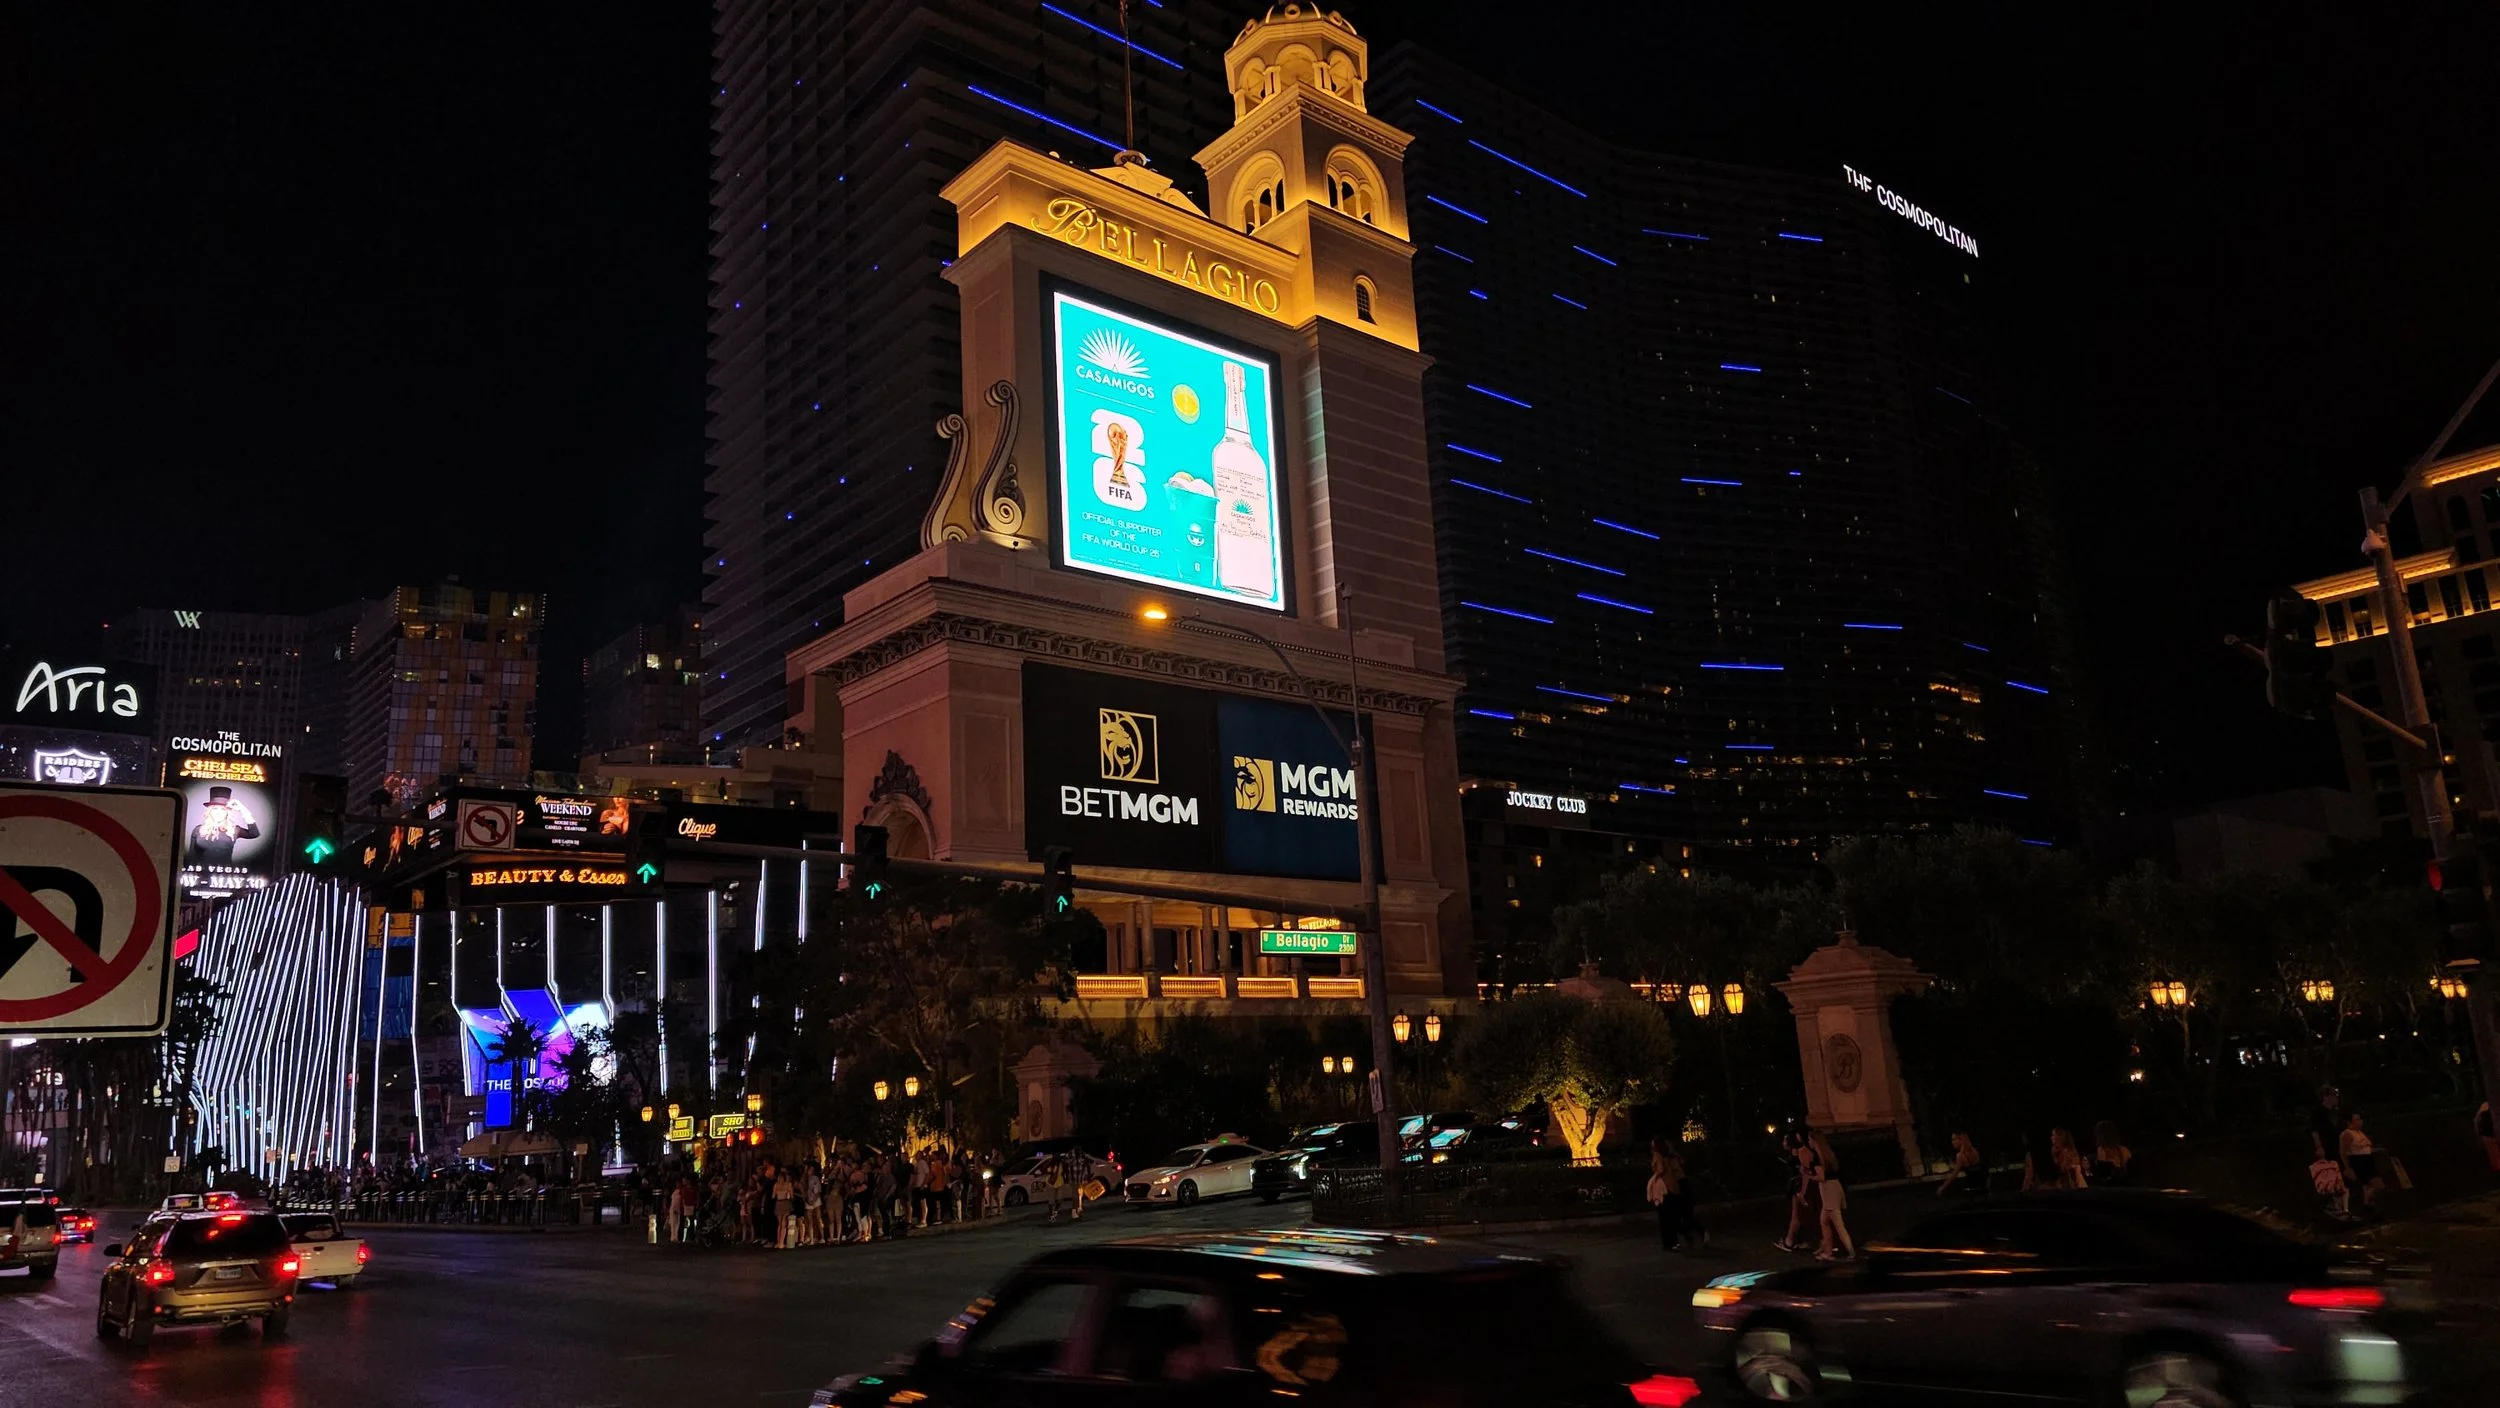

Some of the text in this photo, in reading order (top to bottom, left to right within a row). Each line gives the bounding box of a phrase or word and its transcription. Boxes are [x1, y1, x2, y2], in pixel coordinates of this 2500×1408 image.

[1843, 164, 1979, 258] THE COSMOPOLITAN
[1075, 364, 1155, 399] CASAMIGOS
[1108, 486, 1133, 501] FIFA
[1082, 512, 1162, 536] OFFICIAL SUPPORTER
[1109, 529, 1136, 541] OF THE
[1082, 533, 1100, 545] FIFA
[1100, 537, 1130, 551] WORLD
[1132, 544, 1148, 555] CUP
[218, 731, 240, 741] THE
[171, 737, 282, 758] COSMOPOLITAN
[44, 756, 101, 769] RAIDERS
[184, 759, 263, 775] CHELSEA
[215, 772, 265, 782] CHELSEA
[1280, 762, 1357, 800] MGM
[540, 802, 592, 816] WEEKEND
[1061, 785, 1199, 825] BETMGM
[1283, 798, 1359, 820] REWARDS
[1506, 791, 1587, 814] JOCKEY CLUB
[678, 817, 716, 841] Clique
[209, 876, 245, 889] MAY
[471, 870, 557, 886] BEAUTY
[559, 869, 575, 883] &
[1276, 933, 1329, 951] Bellagio
[1342, 935, 1350, 943] Dr
[1338, 944, 1354, 953] 2300
[487, 1079, 512, 1091] THE
[723, 1116, 745, 1126] SHO
